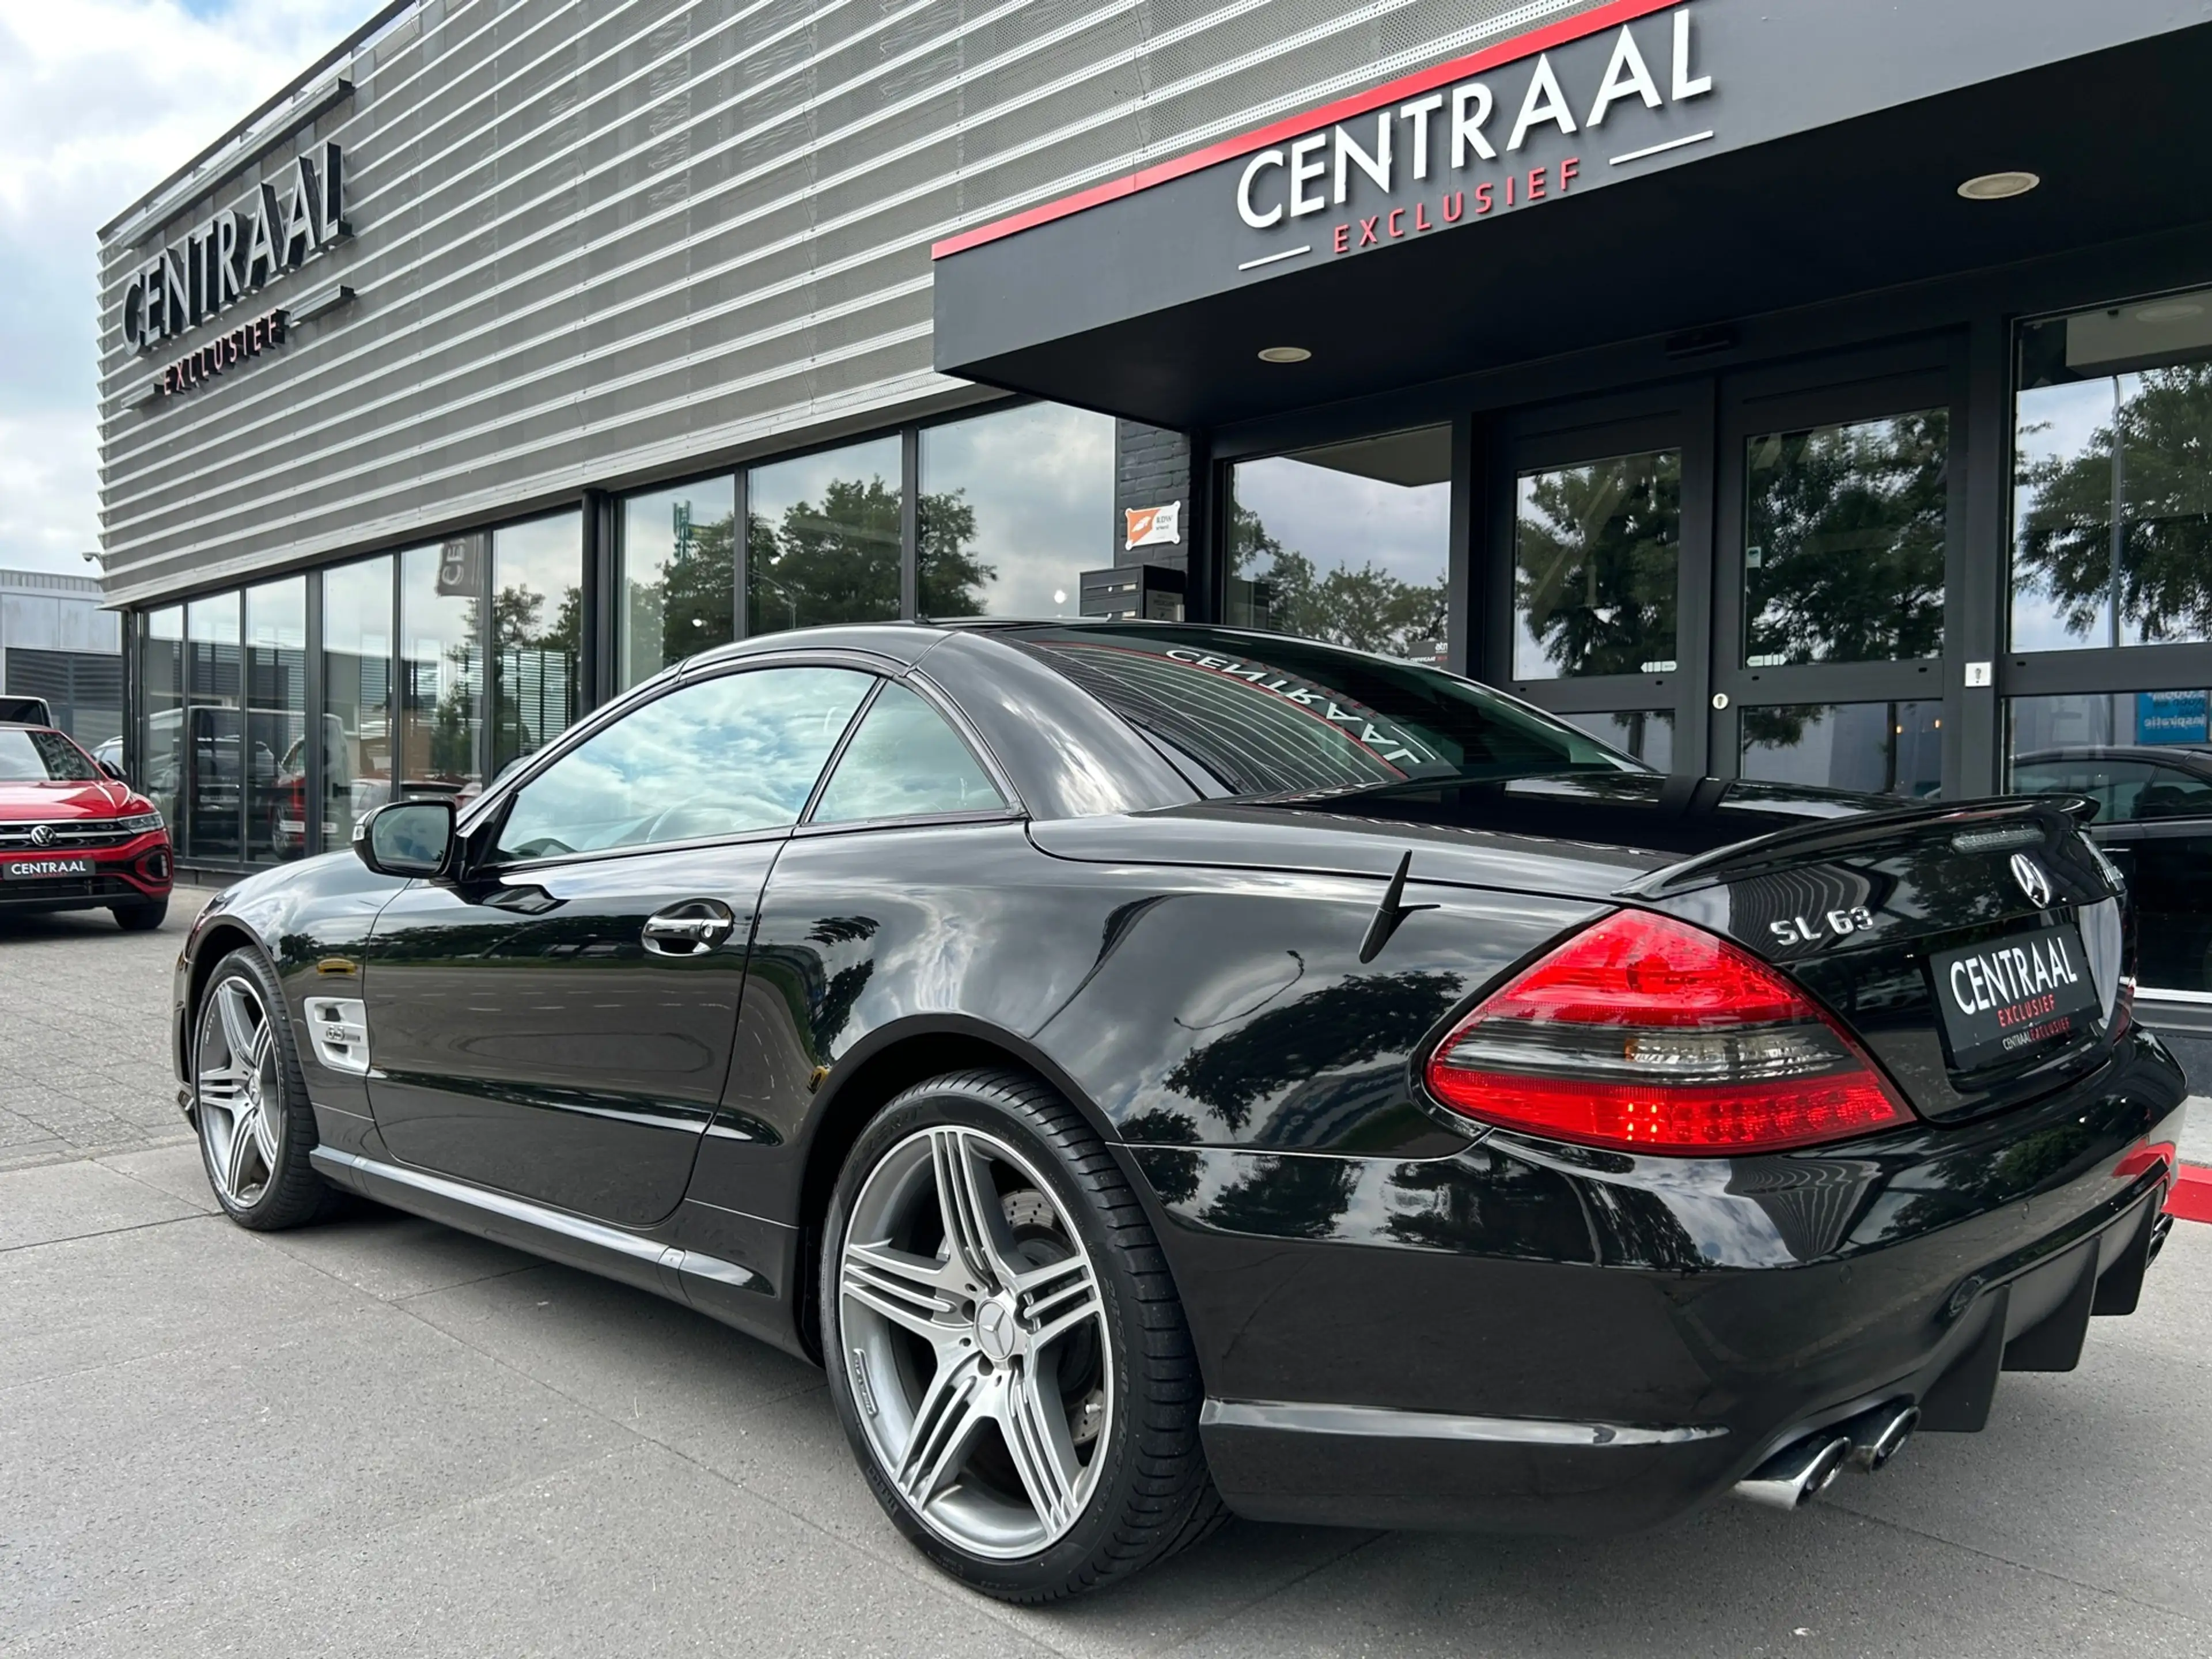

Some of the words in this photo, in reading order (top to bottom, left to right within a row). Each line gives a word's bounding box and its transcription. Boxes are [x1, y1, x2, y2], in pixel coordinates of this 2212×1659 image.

[1237, 8, 1712, 229] CENTRAAL
[1333, 157, 1580, 254] EXCLUSIEF
[122, 141, 349, 356] CENTRAAL
[163, 309, 286, 395] EXCLUSIEF
[10, 860, 86, 875] CENTRAAL
[1770, 916, 1823, 945] SL
[1826, 906, 1873, 935] 63
[1950, 937, 2078, 1015] CENTRAAL
[1997, 994, 2055, 1028] EXCLUSIEF
